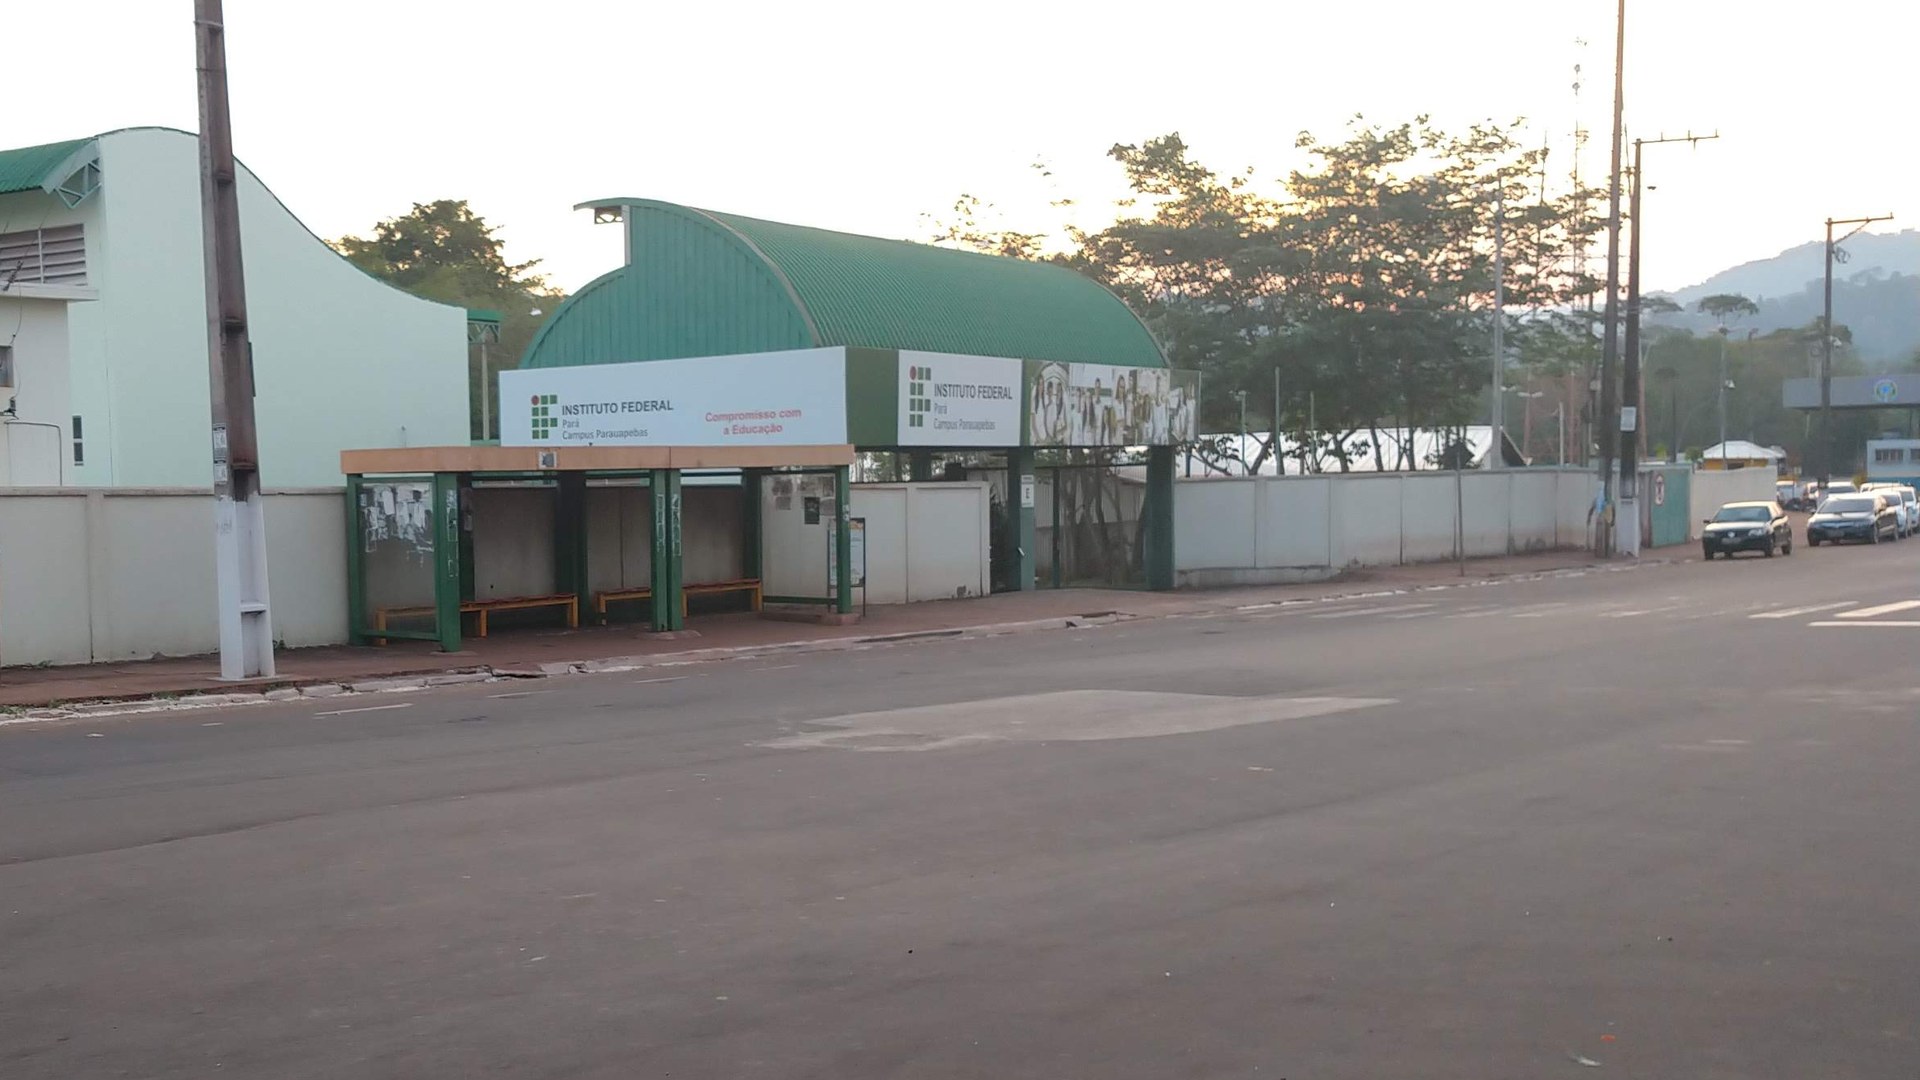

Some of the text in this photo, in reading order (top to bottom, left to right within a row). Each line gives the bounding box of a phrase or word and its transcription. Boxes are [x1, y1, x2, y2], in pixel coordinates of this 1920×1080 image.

[934, 384, 1012, 399] INSTITUTO FEDERAL
[562, 400, 673, 415] INSTITUTO FEDERAL
[705, 409, 802, 423] Compromisso com
[562, 419, 580, 428] Pará
[723, 424, 783, 435] a Educação
[933, 418, 957, 430] Campus
[562, 428, 648, 440] Campus Parauapebas
